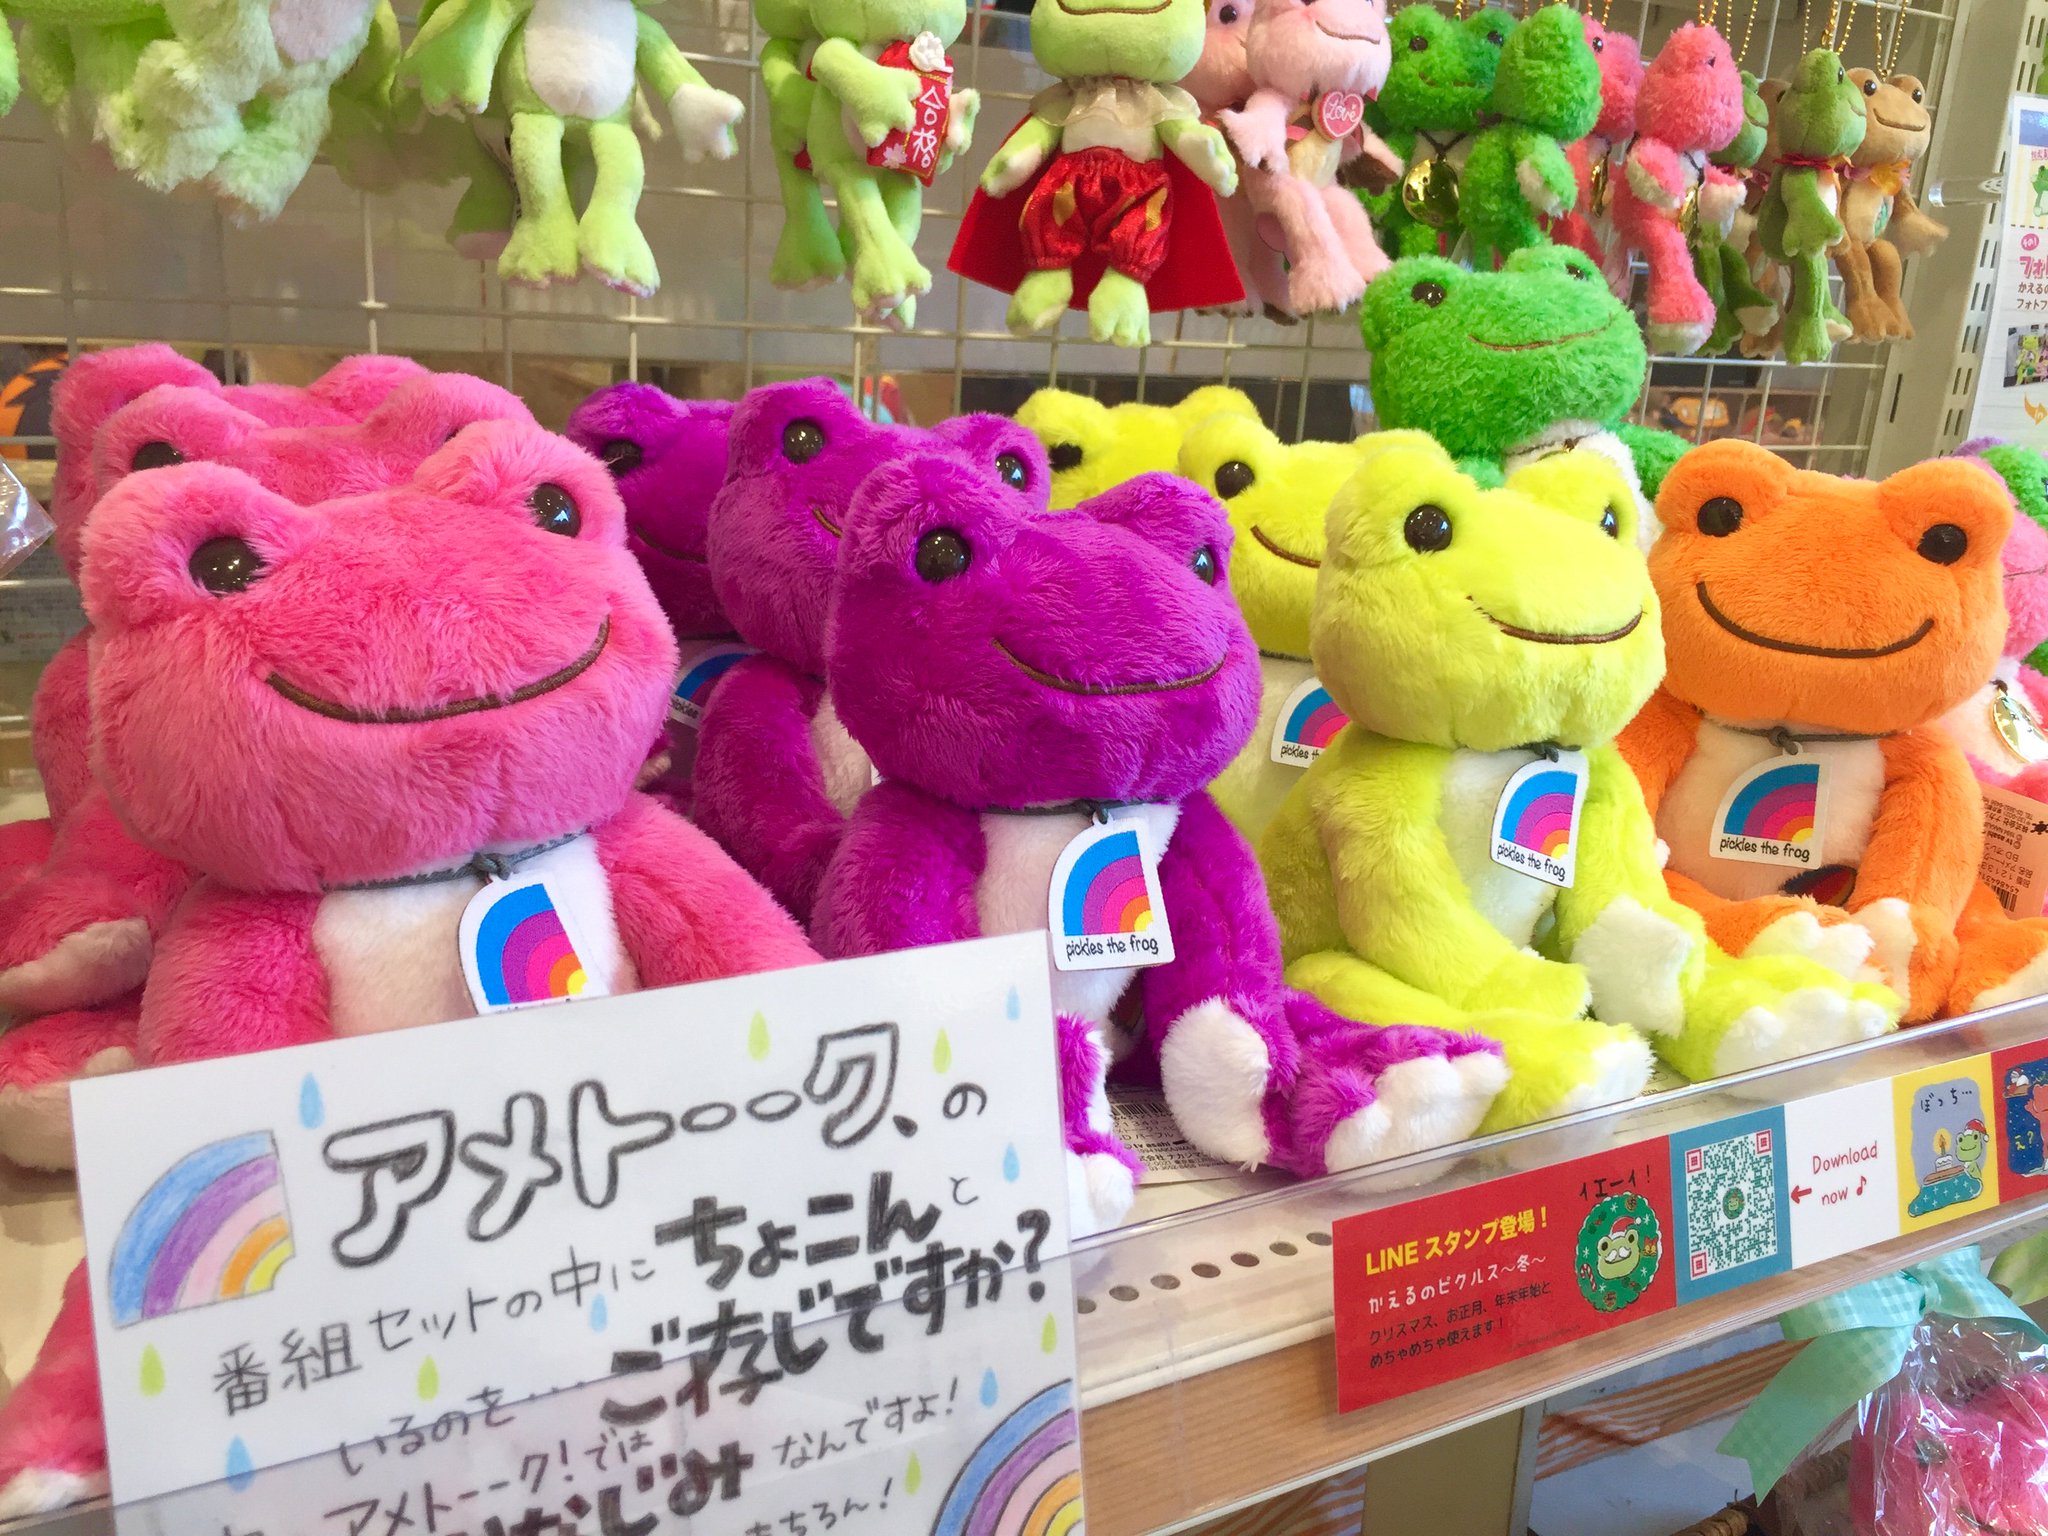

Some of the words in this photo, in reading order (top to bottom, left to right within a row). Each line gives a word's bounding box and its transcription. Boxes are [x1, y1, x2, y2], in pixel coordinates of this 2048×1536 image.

[912, 85, 946, 168] 合格
[1326, 102, 1358, 123] Love
[1280, 744, 1309, 759] pickles
[1497, 843, 1526, 865] pickles
[1527, 852, 1542, 870] the
[1544, 859, 1566, 882] frog
[1719, 837, 1758, 854] pickles
[1760, 841, 1780, 856] the
[1783, 843, 1811, 863] frog
[1065, 937, 1104, 961] pickles
[1106, 936, 1126, 953] the
[1130, 934, 1159, 955] frog
[1811, 1140, 1879, 1175] Download
[1821, 1188, 1849, 1206] now
[1365, 1240, 1420, 1276] LINE
[213, 1246, 656, 1418] 番組セットの中に
